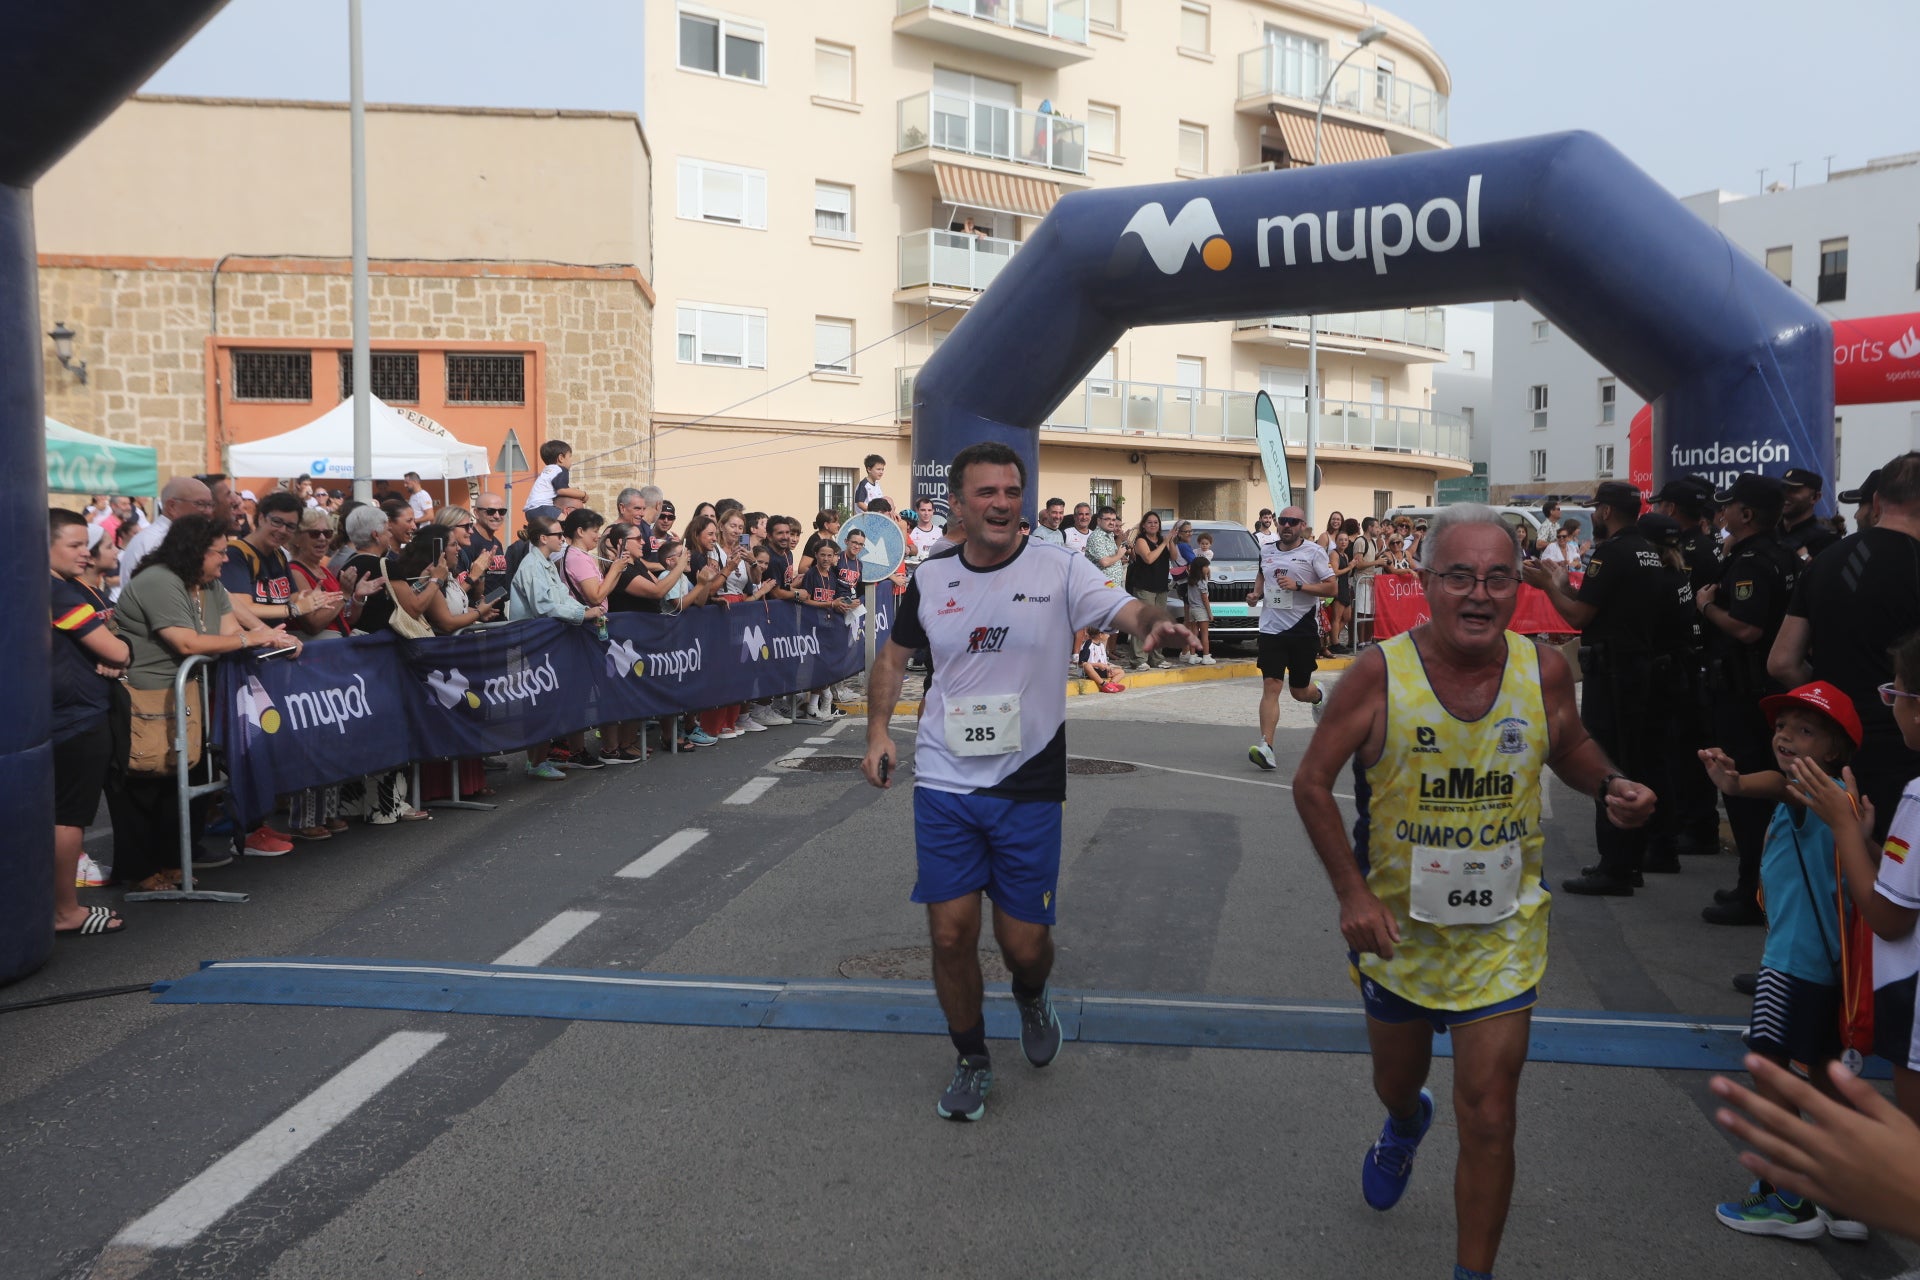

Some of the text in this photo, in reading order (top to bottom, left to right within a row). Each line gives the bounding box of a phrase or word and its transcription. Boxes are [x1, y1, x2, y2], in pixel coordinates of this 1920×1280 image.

[1257, 174, 1482, 275] mupol
[1671, 439, 1790, 467] fundación
[918, 482, 949, 499] mup
[1029, 595, 1051, 603] mupol
[1388, 579, 1424, 600] Sports
[773, 627, 820, 663] mupol
[649, 638, 701, 682] mupol
[484, 653, 560, 706] mupol
[284, 673, 373, 734] mupol
[965, 727, 996, 742] 285
[1396, 819, 1474, 848] OLIMPO
[1448, 889, 1493, 908] 648
